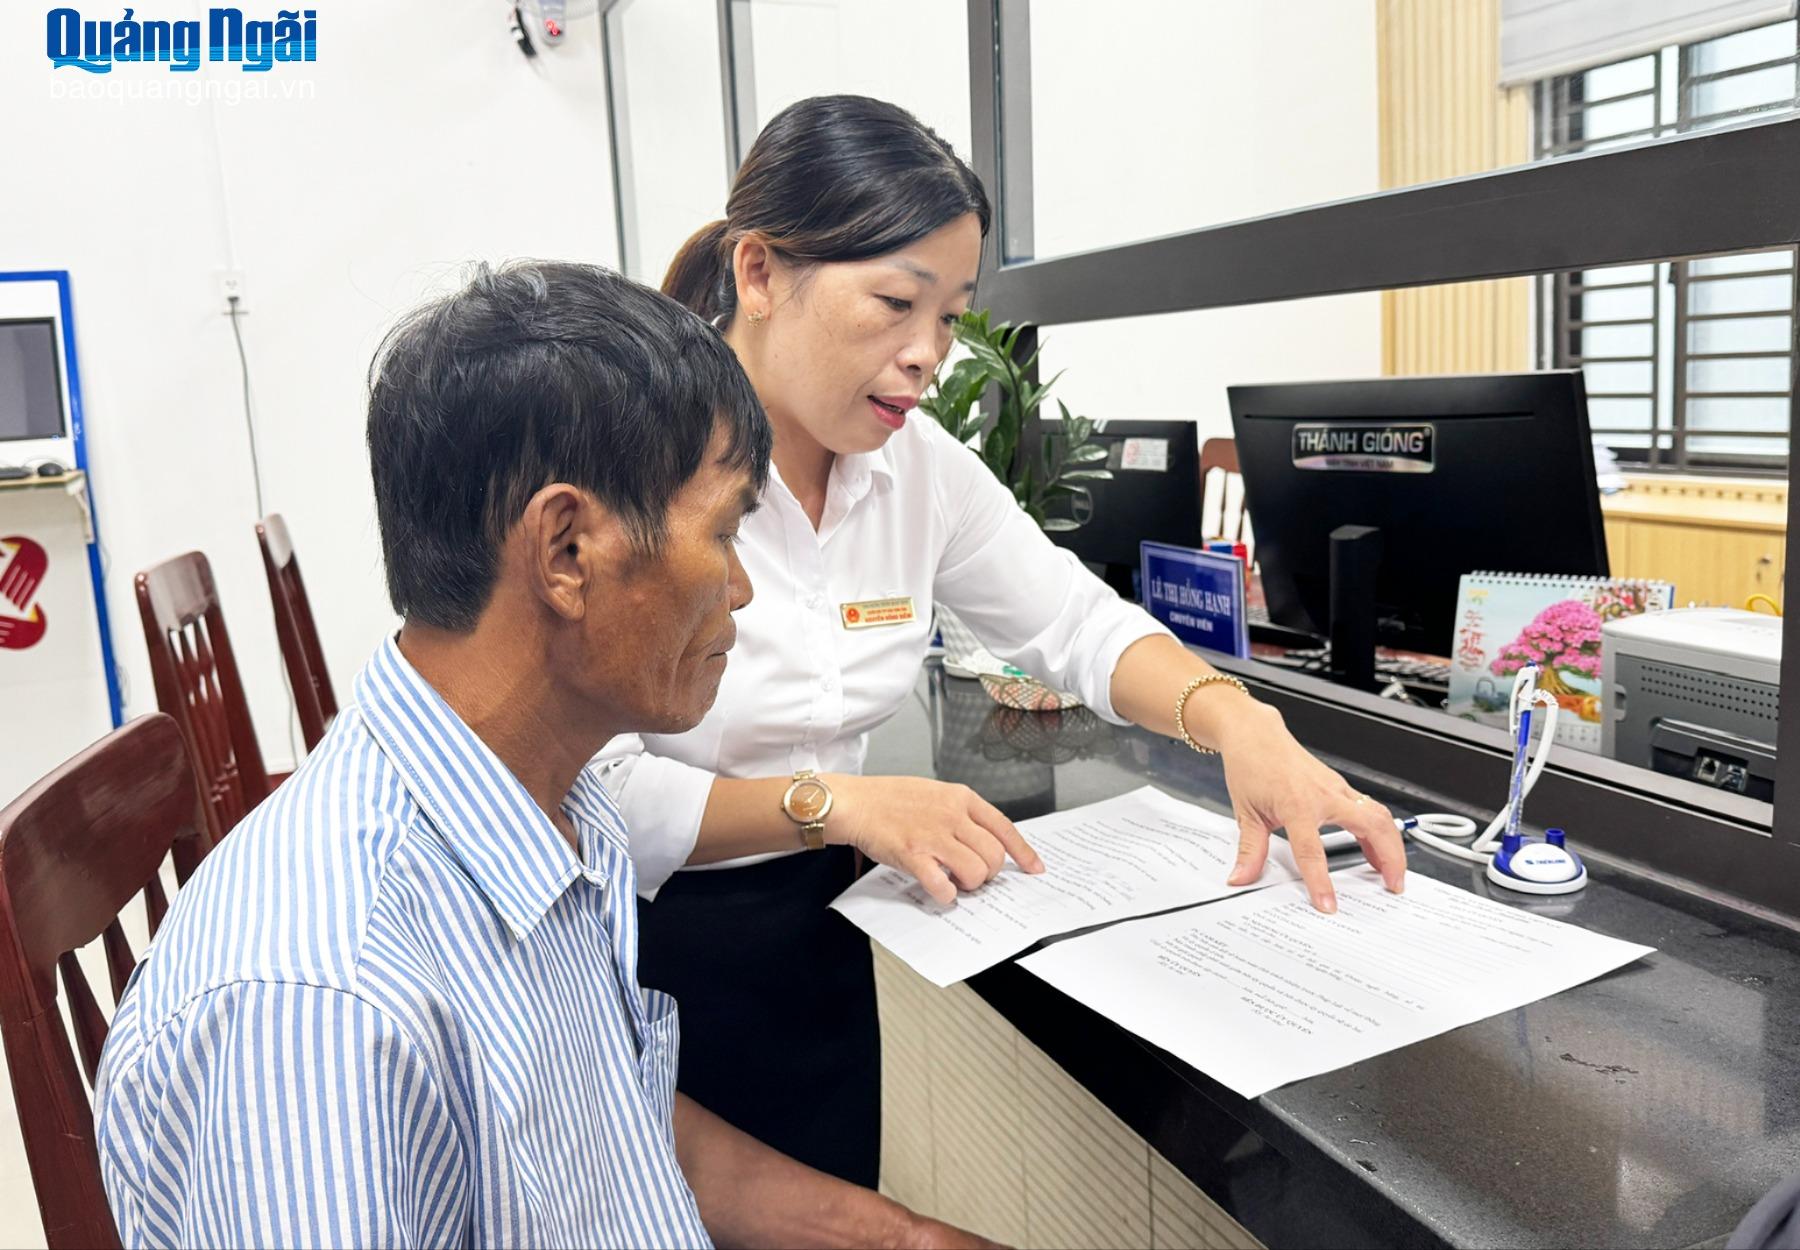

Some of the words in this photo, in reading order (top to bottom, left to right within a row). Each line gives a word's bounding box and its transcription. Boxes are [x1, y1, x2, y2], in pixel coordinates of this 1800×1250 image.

[1298, 428, 1357, 452] THÁNH
[1362, 428, 1424, 453] GIÓNG
[1151, 576, 1164, 599] LÊ
[1163, 582, 1178, 607] THỊ
[1204, 591, 1232, 617] HẠNH
